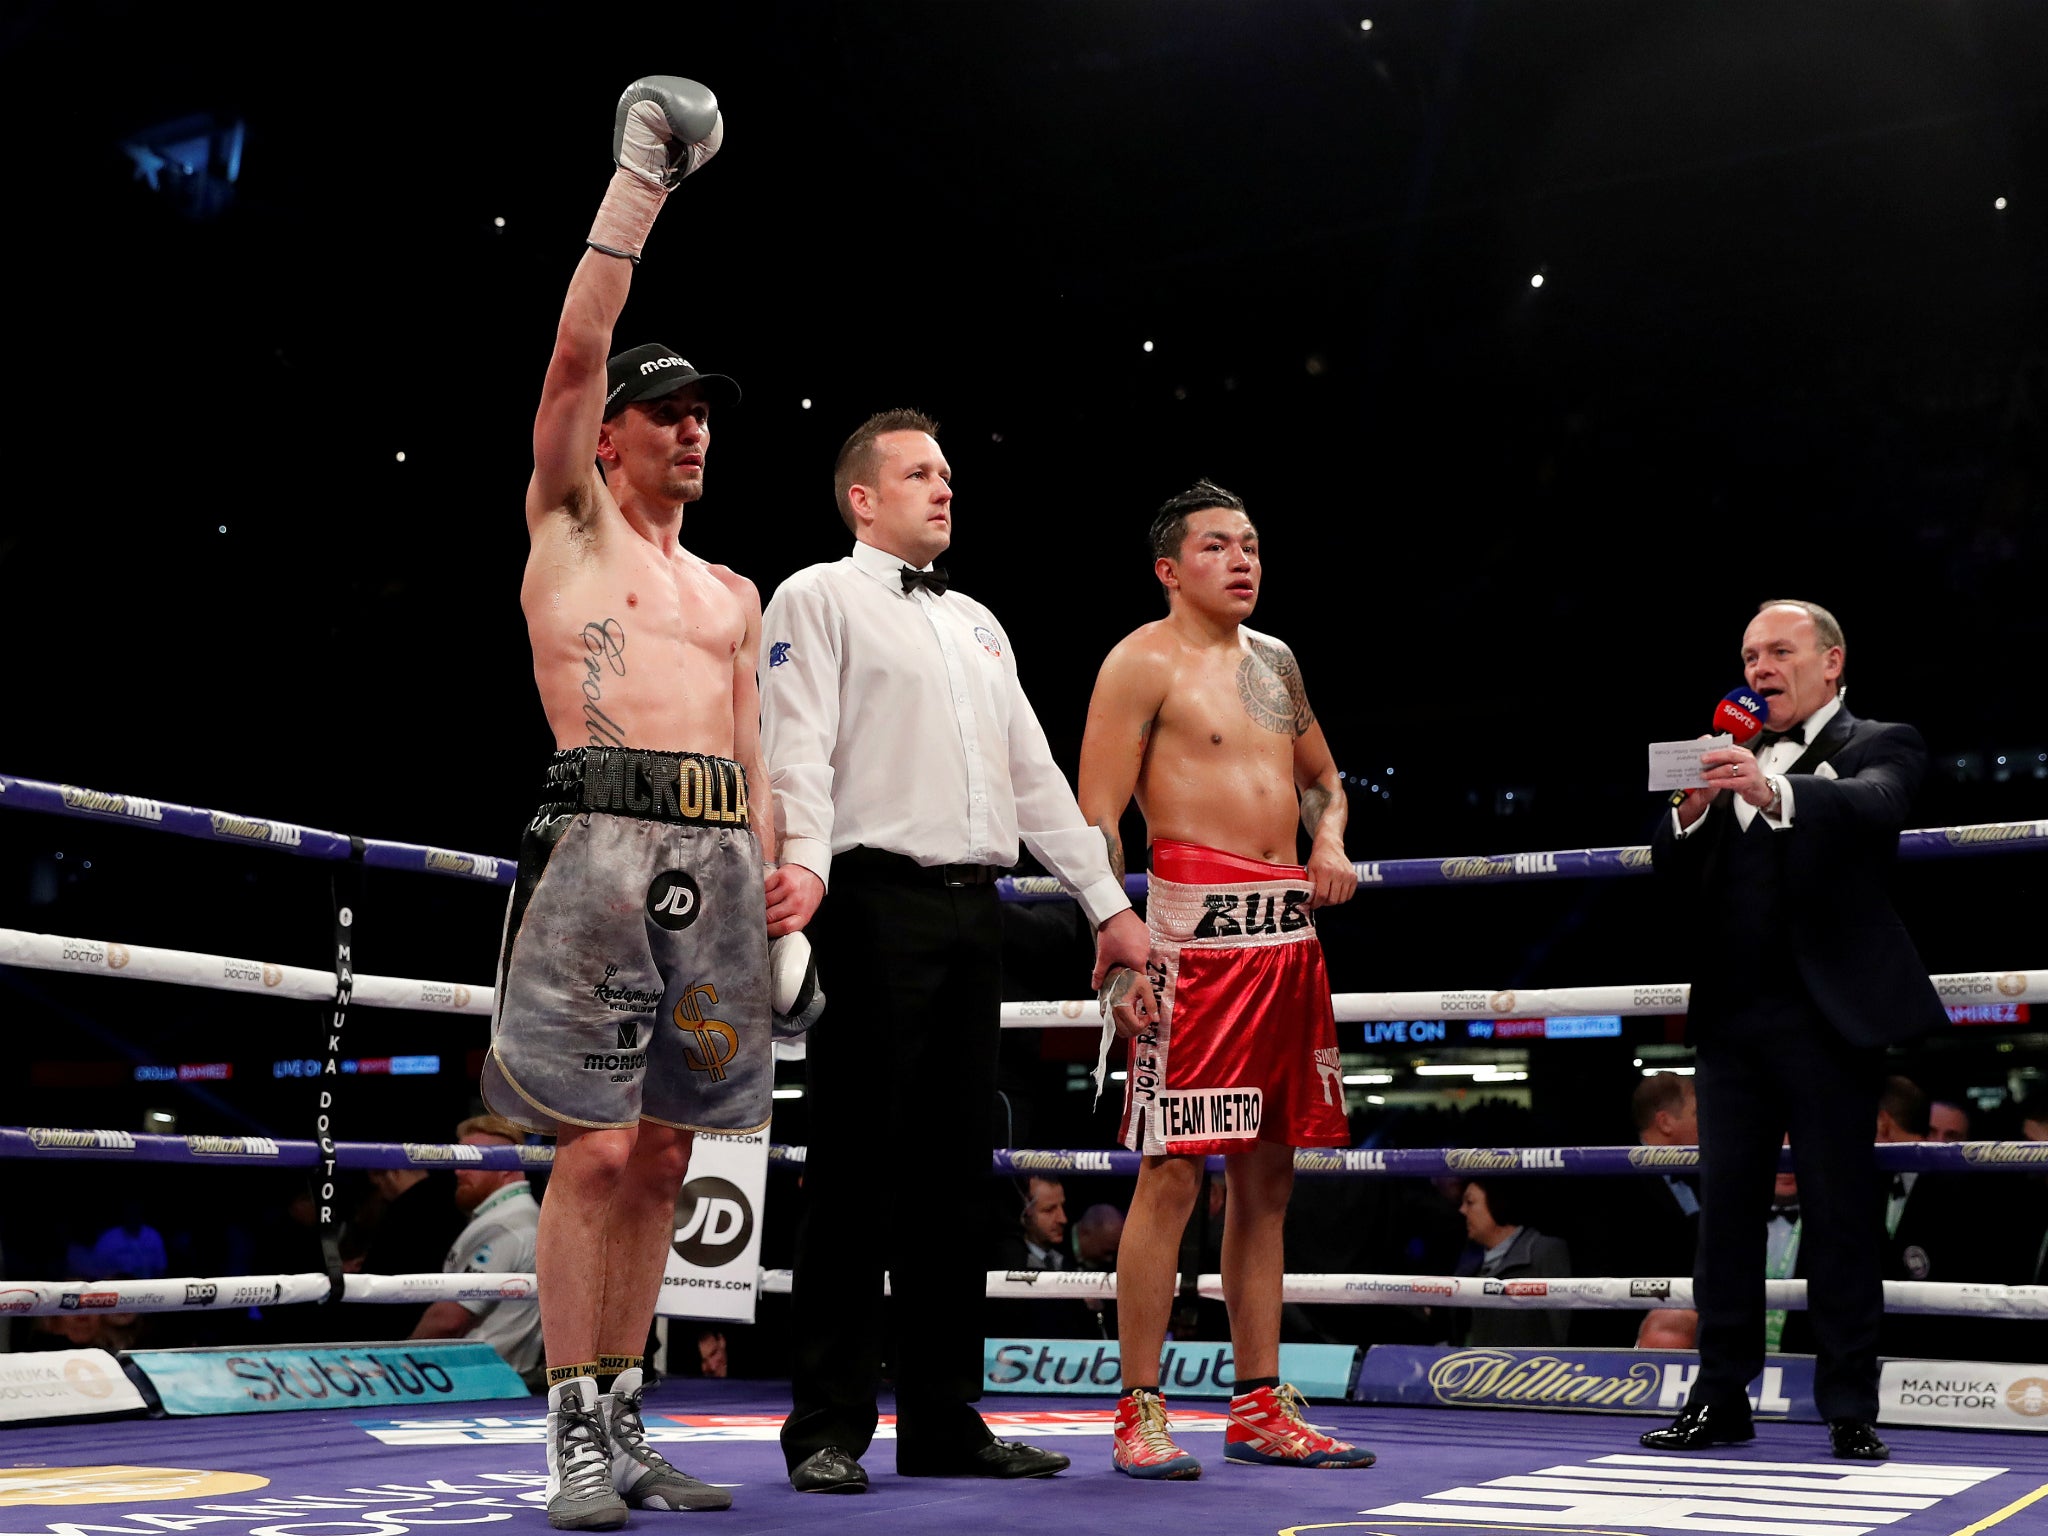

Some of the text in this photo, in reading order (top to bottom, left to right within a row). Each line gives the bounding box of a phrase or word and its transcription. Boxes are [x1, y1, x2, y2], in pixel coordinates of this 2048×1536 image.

[1738, 695, 1760, 713] sky
[1723, 704, 1756, 730] sports
[1352, 863, 1383, 882] ILL
[1441, 853, 1557, 880] William HILL
[654, 885, 694, 916] JD
[1194, 889, 1315, 939] RUB
[224, 968, 261, 982] DOCTOR
[1938, 984, 1993, 996] DOCTOR
[1441, 1001, 1487, 1012] DOCTOR
[1634, 995, 1683, 1006] DOCTOR
[1364, 1022, 1408, 1043] LIVE
[1409, 1020, 1446, 1042] ON
[1159, 1092, 1260, 1137] TEAM METRO
[317, 1091, 335, 1223] DOCTOR
[1011, 1149, 1112, 1170] William HILL
[1346, 1151, 1386, 1171] HILL
[1445, 1149, 1565, 1169] William HILL
[674, 1197, 744, 1246] JD
[235, 1287, 272, 1297] JOSEPH
[664, 1276, 752, 1291] DSPORTS.COM
[599, 1356, 629, 1368] SUZI
[225, 1353, 455, 1400] StubHub
[550, 1366, 578, 1381] SUZI
[1428, 1350, 1791, 1413] William HL
[1901, 1379, 1998, 1393] MANUKA
[1900, 1393, 1996, 1409] DOCTOR
